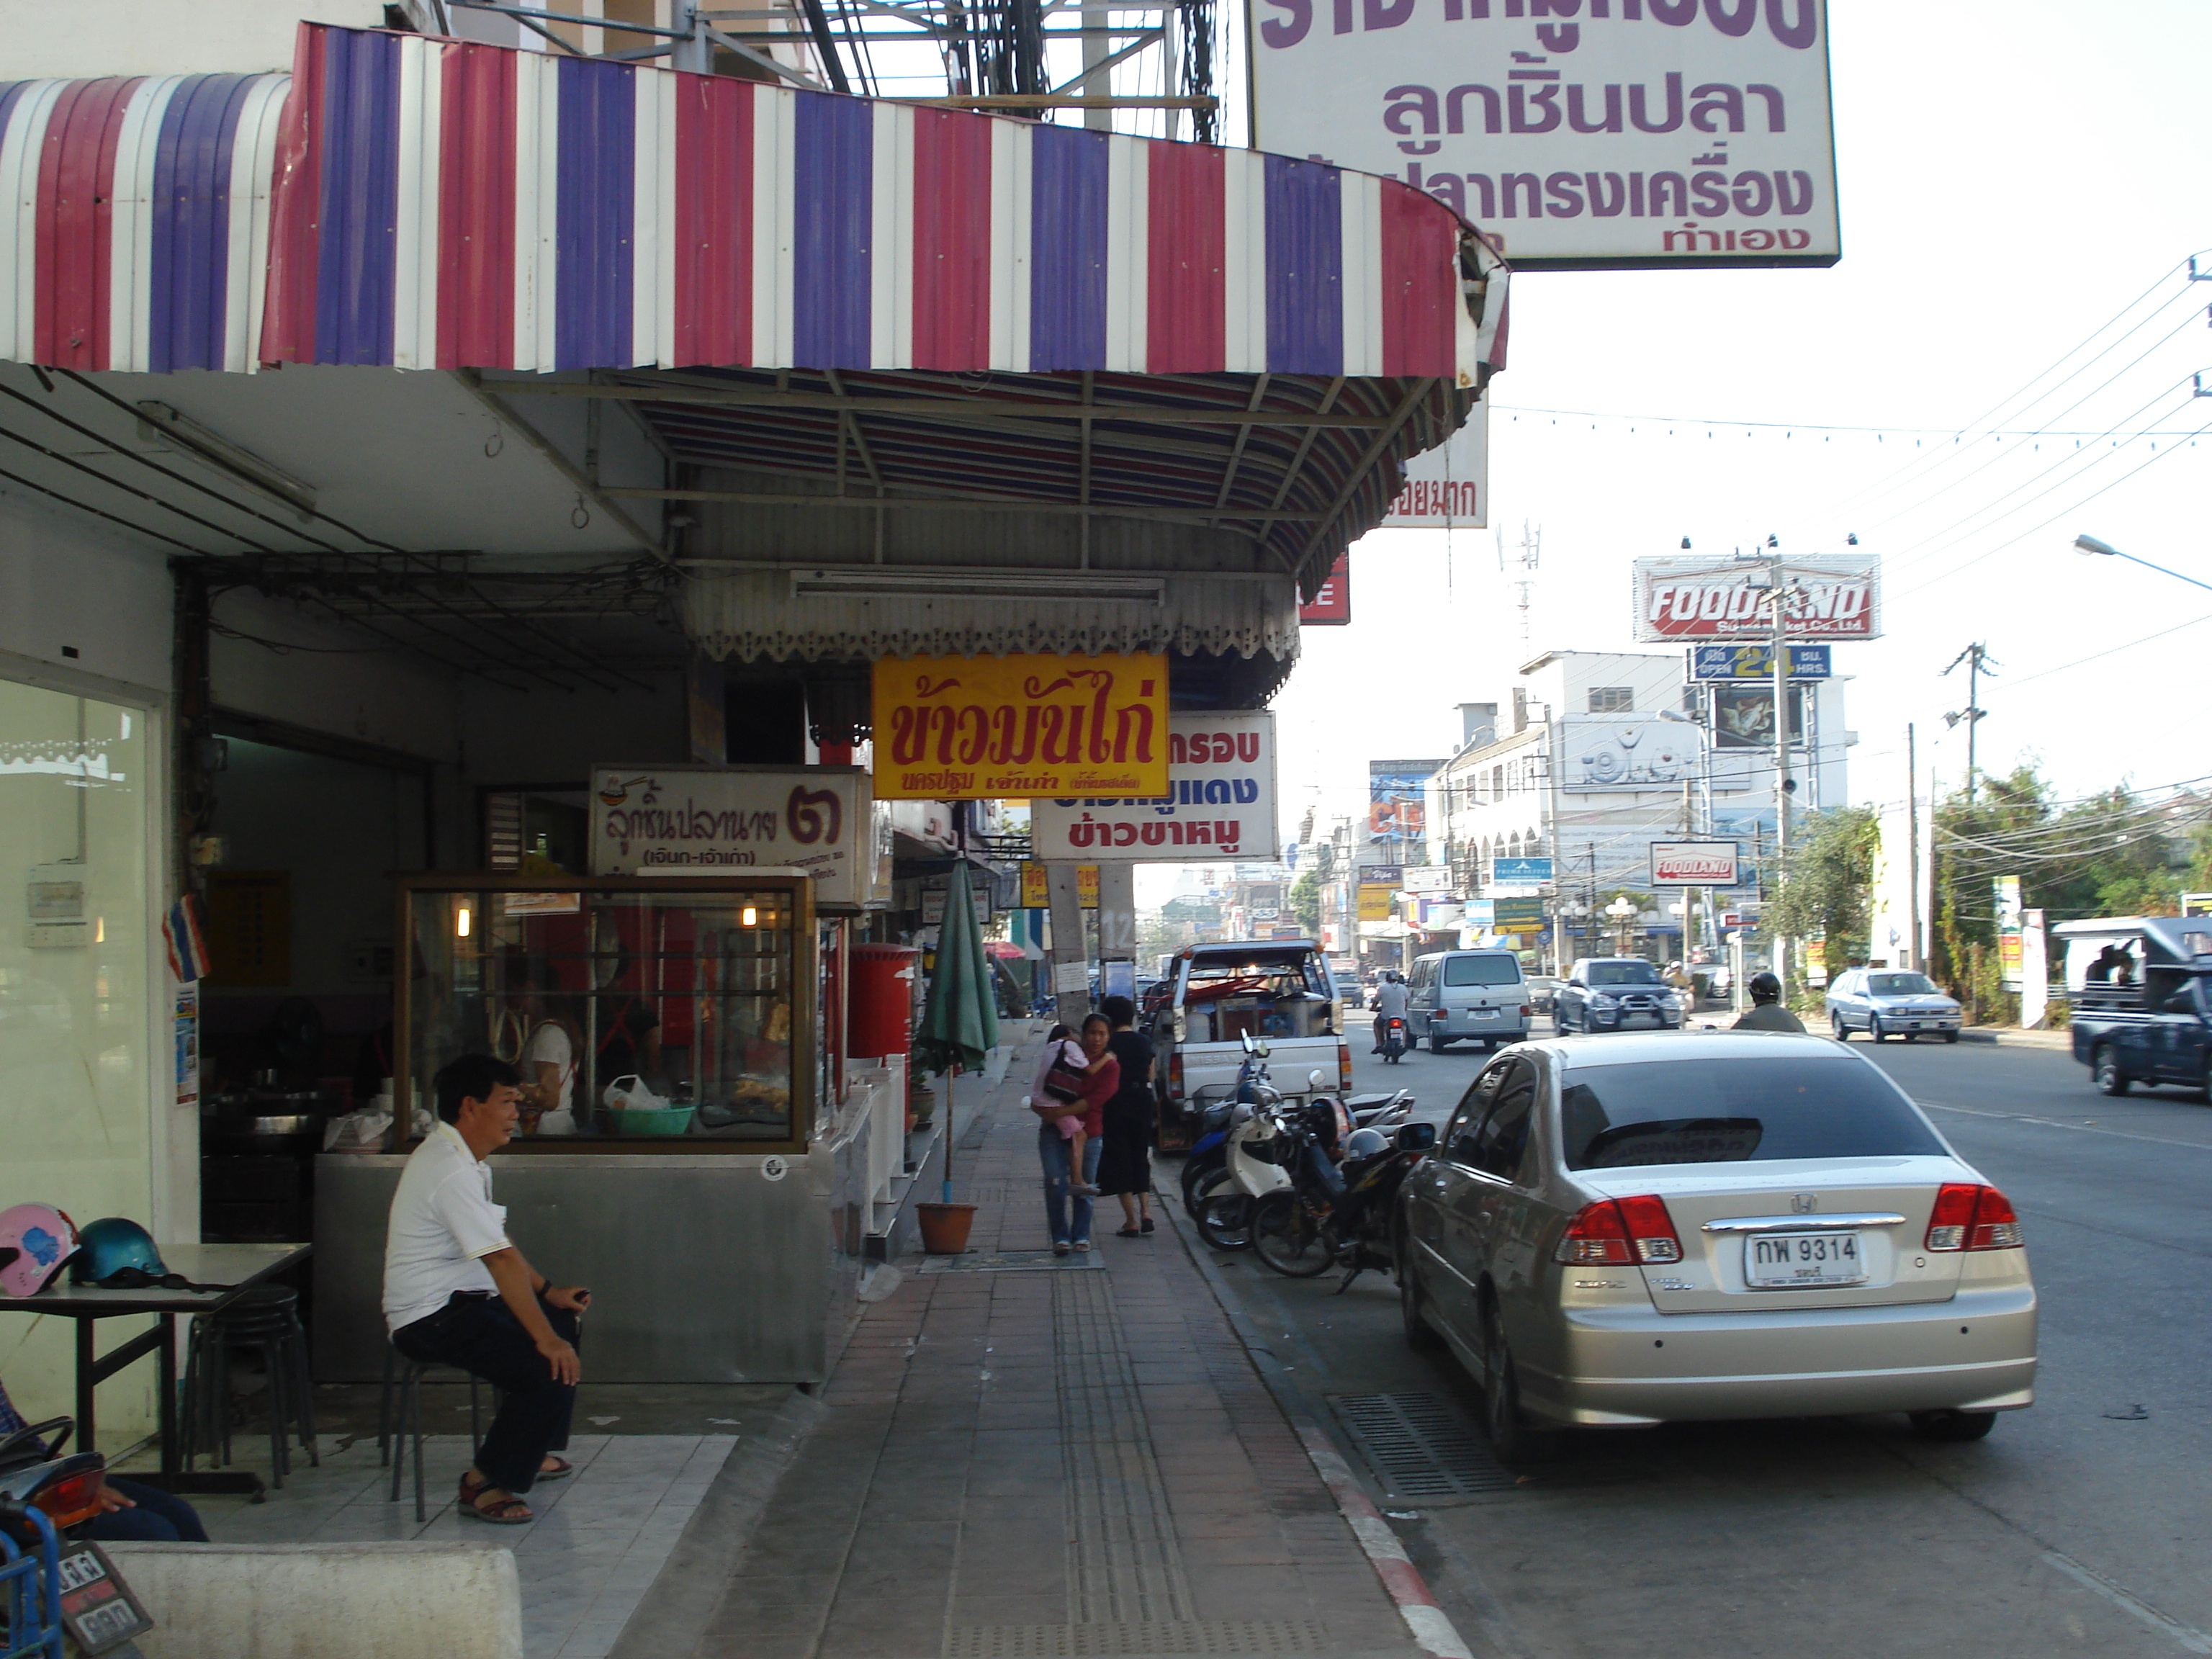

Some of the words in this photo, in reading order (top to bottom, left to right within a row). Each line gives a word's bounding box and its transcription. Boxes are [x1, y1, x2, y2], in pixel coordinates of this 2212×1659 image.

[1383, 50, 1786, 155] ลูกชิ้นปลา
[1663, 222, 1811, 252] ทำเอง
[1838, 620, 1865, 632] Ltd.
[1699, 664, 1732, 674] OPEN
[1797, 663, 1827, 674] HRS.
[1735, 647, 1795, 677] 24
[891, 670, 1156, 765] ข้าวมันไก่
[986, 771, 1058, 790] เจ้าเก่า
[1069, 813, 1240, 853] ข้าวขาหมู
[1657, 860, 1730, 873] FOODLAND
[1101, 912, 1134, 949] 12
[1799, 1238, 1856, 1261] 9314
